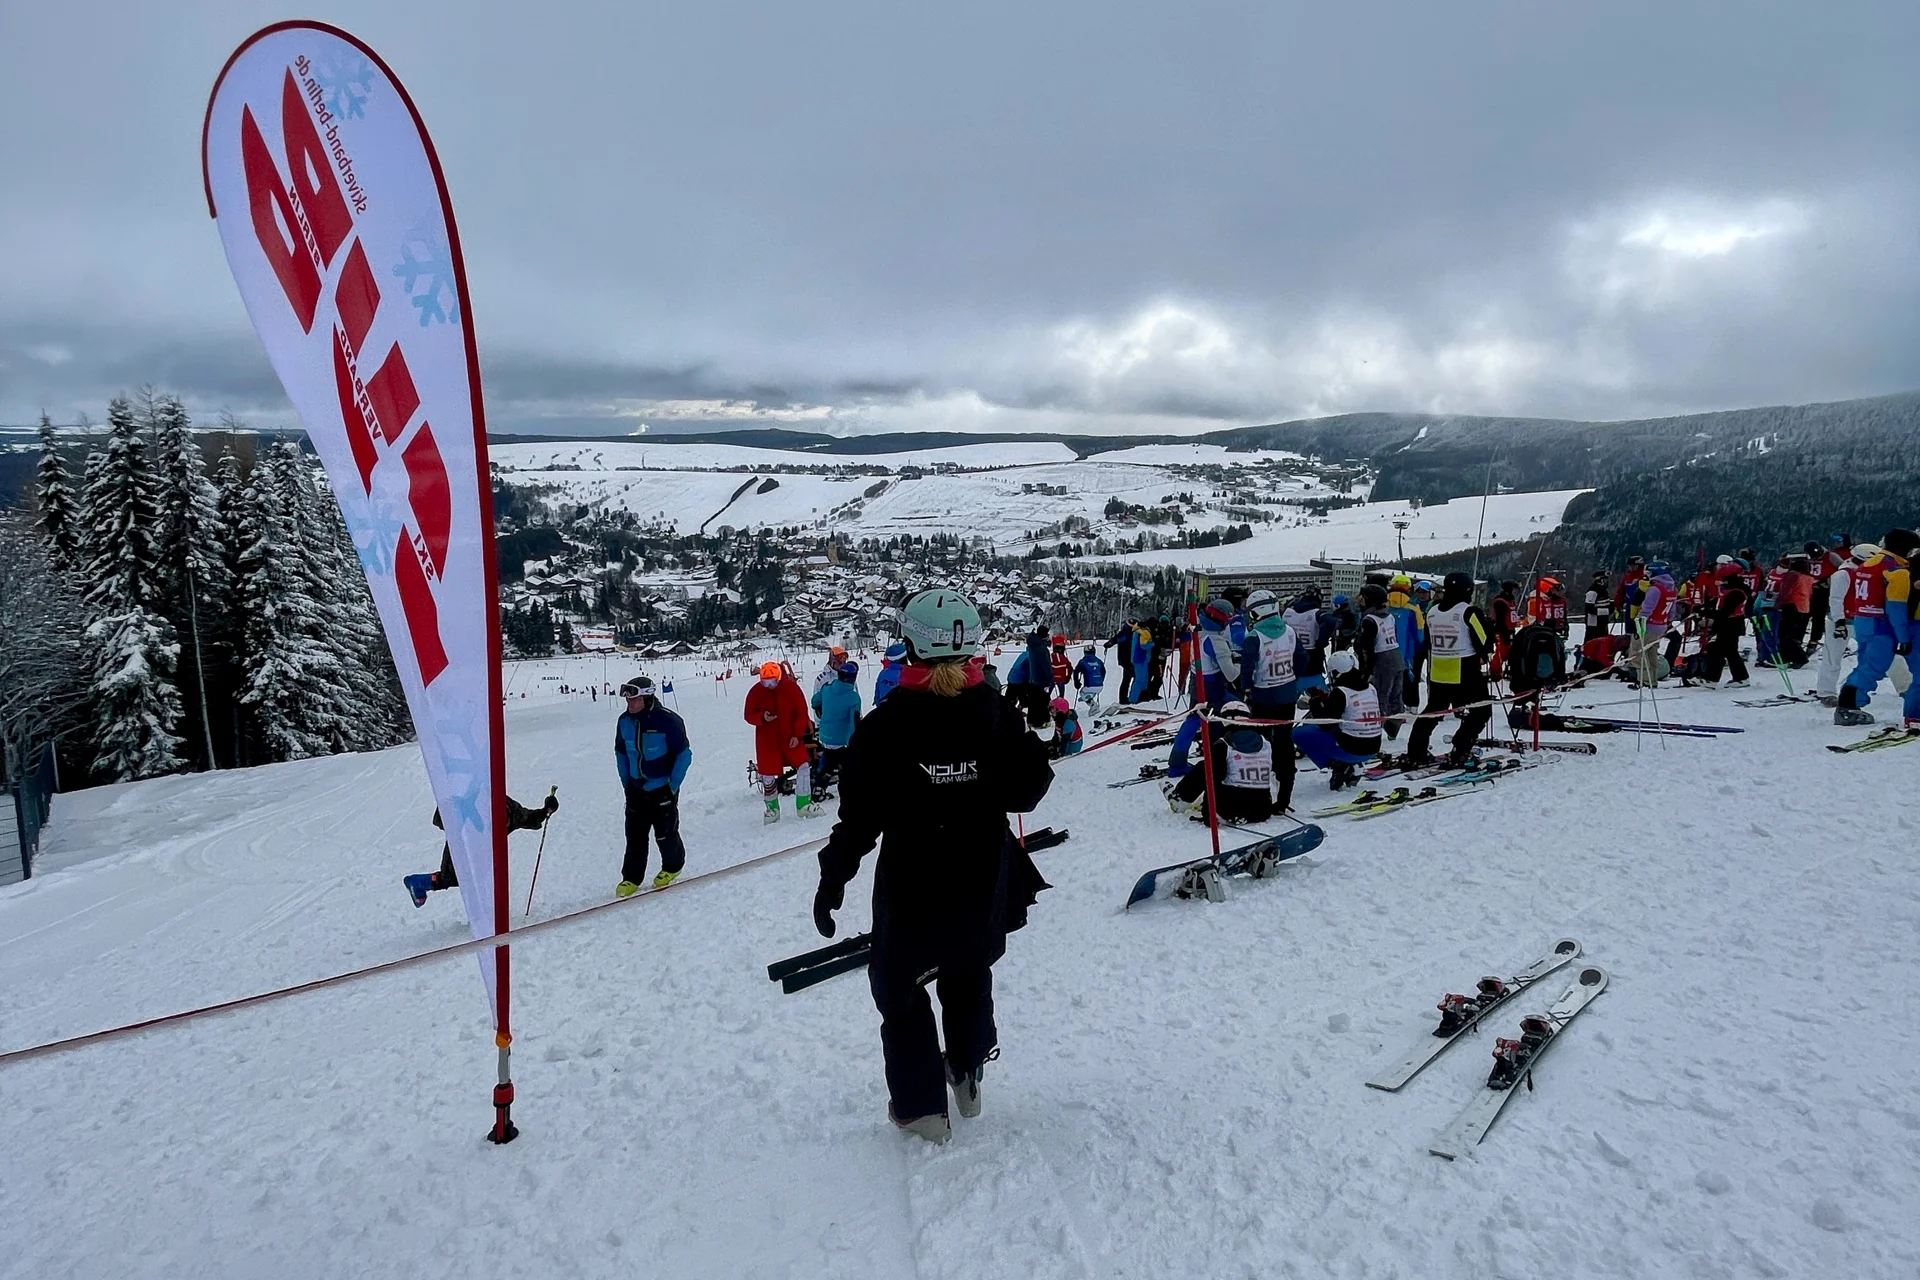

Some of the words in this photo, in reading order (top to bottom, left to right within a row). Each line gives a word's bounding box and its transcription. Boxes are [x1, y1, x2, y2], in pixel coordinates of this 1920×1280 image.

[1268, 660, 1293, 678] 103
[930, 775, 954, 784] TEAM
[955, 773, 978, 782] WEAR
[1239, 767, 1270, 782] 102
